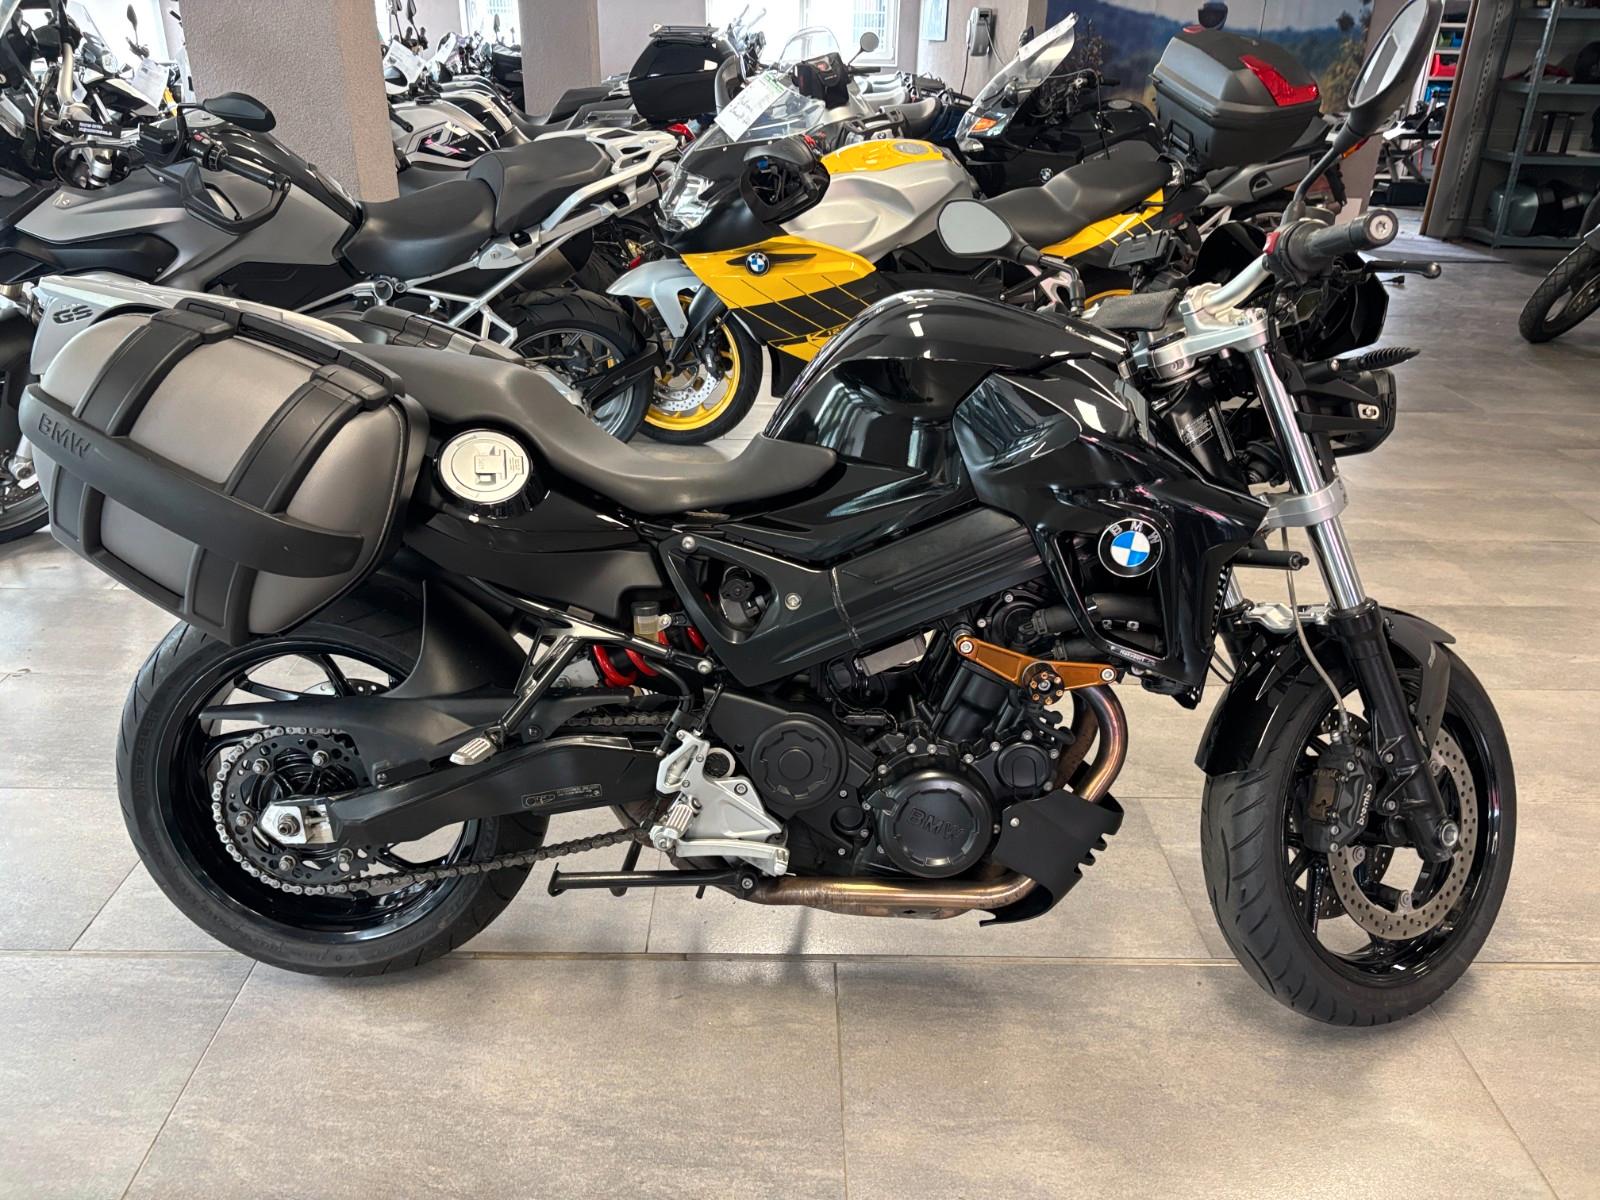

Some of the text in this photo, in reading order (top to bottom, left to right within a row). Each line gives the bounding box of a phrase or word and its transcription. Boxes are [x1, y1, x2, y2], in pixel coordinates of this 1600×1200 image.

[53, 305, 93, 324] GS
[38, 413, 91, 457] BMW
[1109, 520, 1161, 544] BMW
[134, 709, 159, 801] METZELER
[1356, 783, 1373, 826] brembo
[909, 807, 968, 841] BMW
